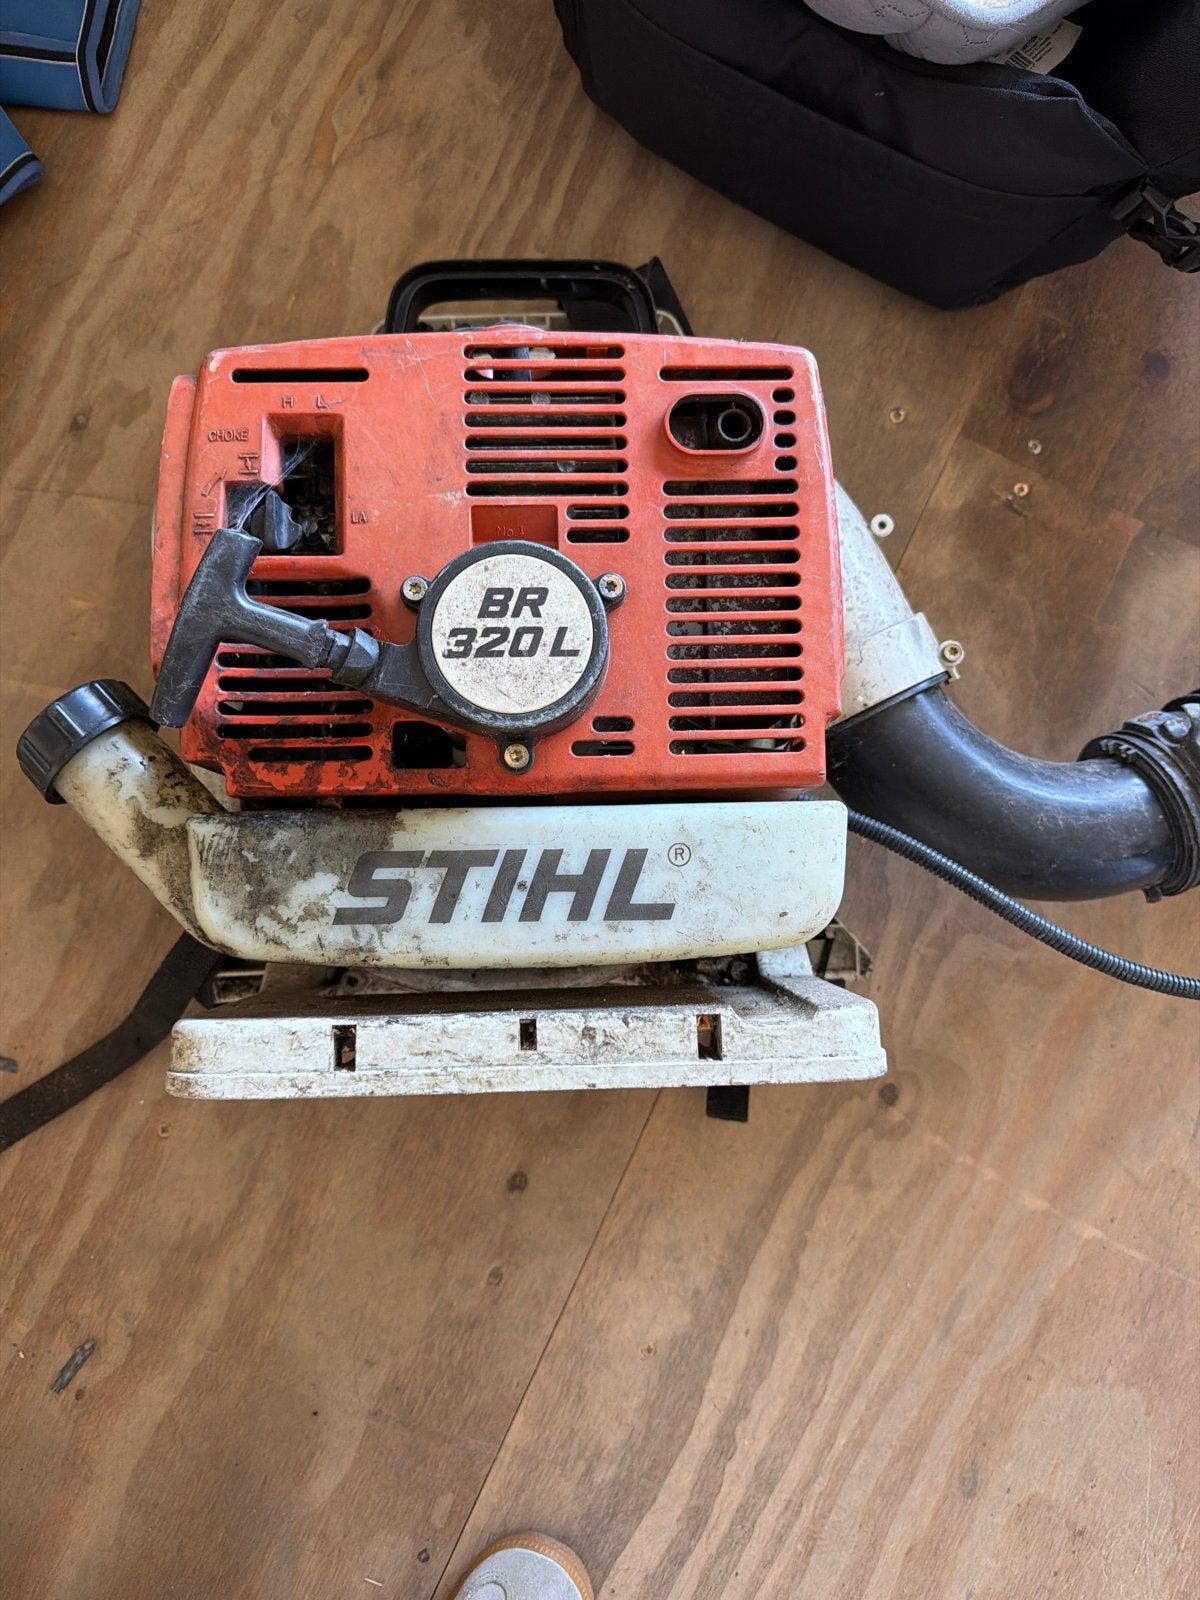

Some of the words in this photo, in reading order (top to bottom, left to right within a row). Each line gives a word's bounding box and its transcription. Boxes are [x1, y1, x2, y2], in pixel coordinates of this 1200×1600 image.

[282, 396, 294, 408] H
[316, 395, 330, 408] L
[208, 429, 249, 442] CHOKE
[351, 511, 368, 524] LA
[477, 587, 549, 619] BR
[442, 626, 544, 659] 320
[549, 627, 581, 657] L
[332, 848, 676, 925] STIHL
